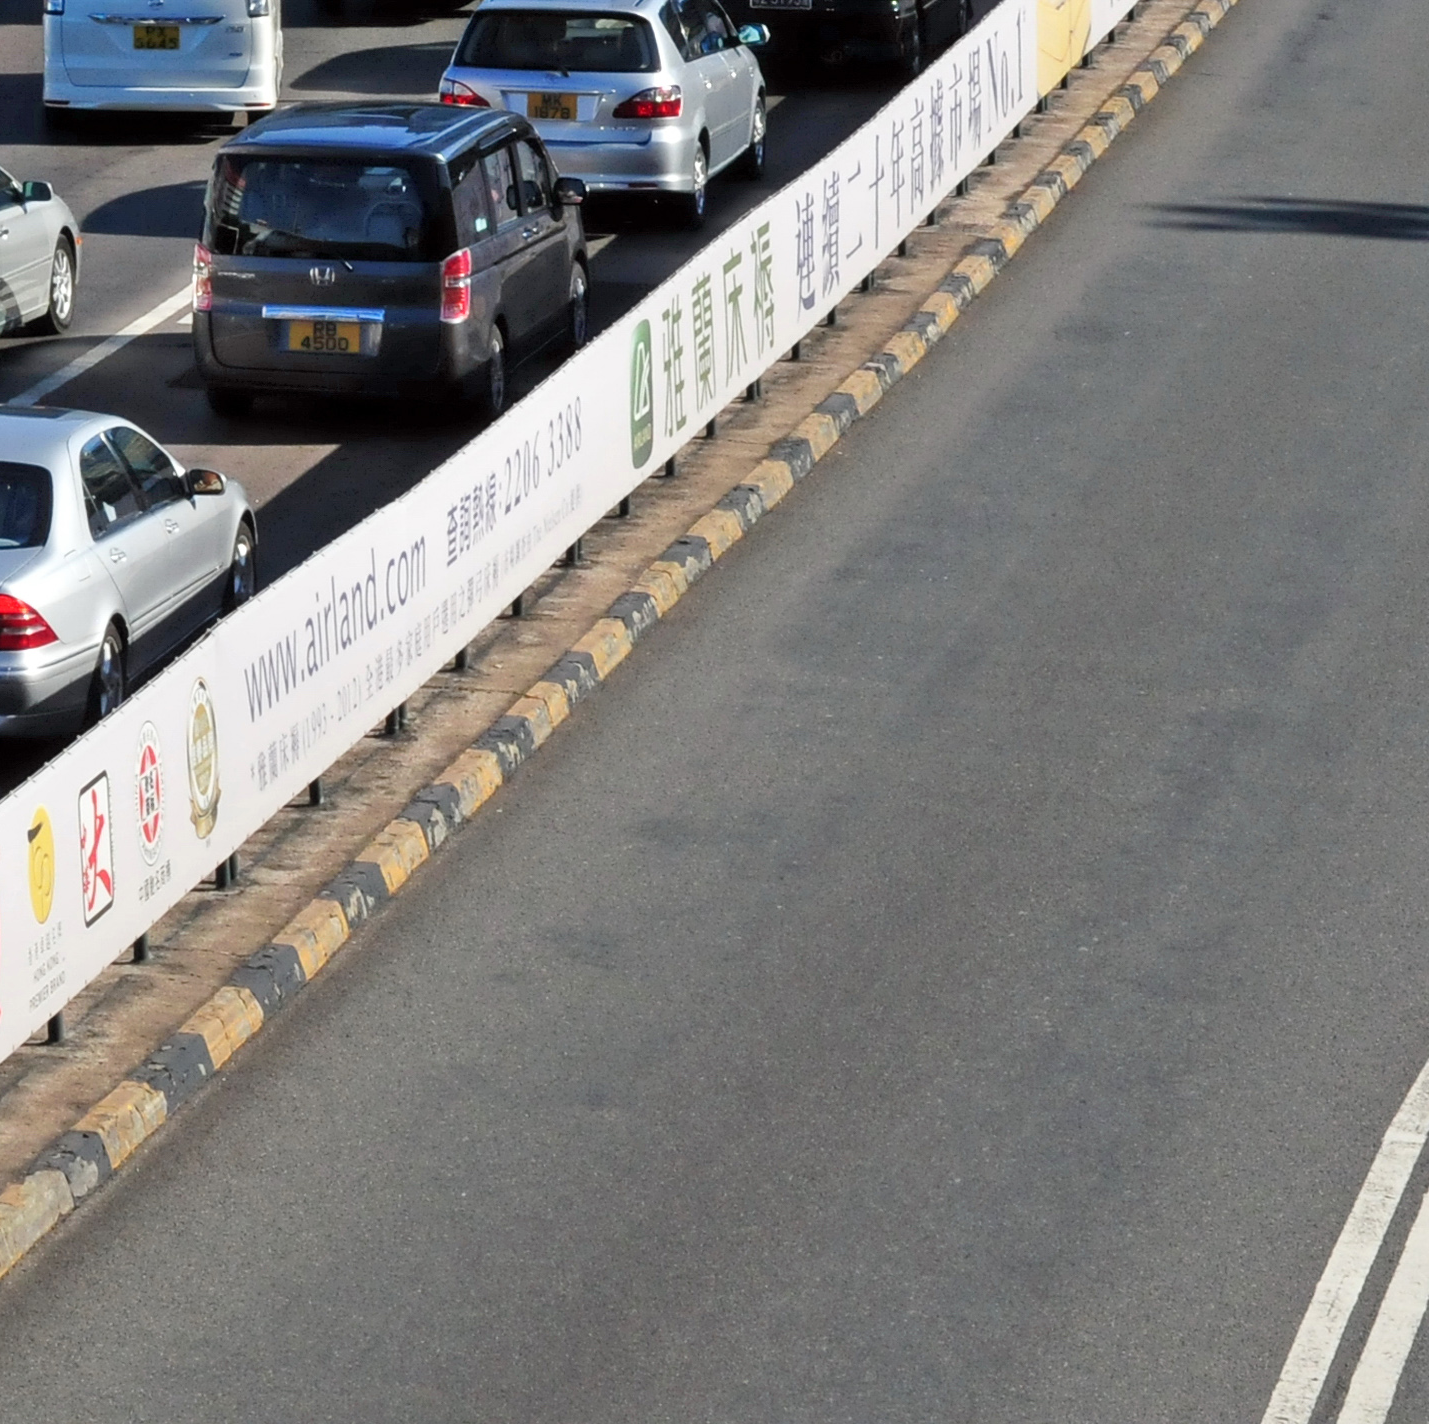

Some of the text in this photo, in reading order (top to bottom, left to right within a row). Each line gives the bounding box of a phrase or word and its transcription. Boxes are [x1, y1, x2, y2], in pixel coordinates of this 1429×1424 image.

[300, 336, 349, 351] 4500
[313, 321, 337, 336] RB
[662, 220, 776, 439] 雅蘭床褥
[548, 396, 583, 477] 3388
[244, 535, 427, 723] www.airland.com
